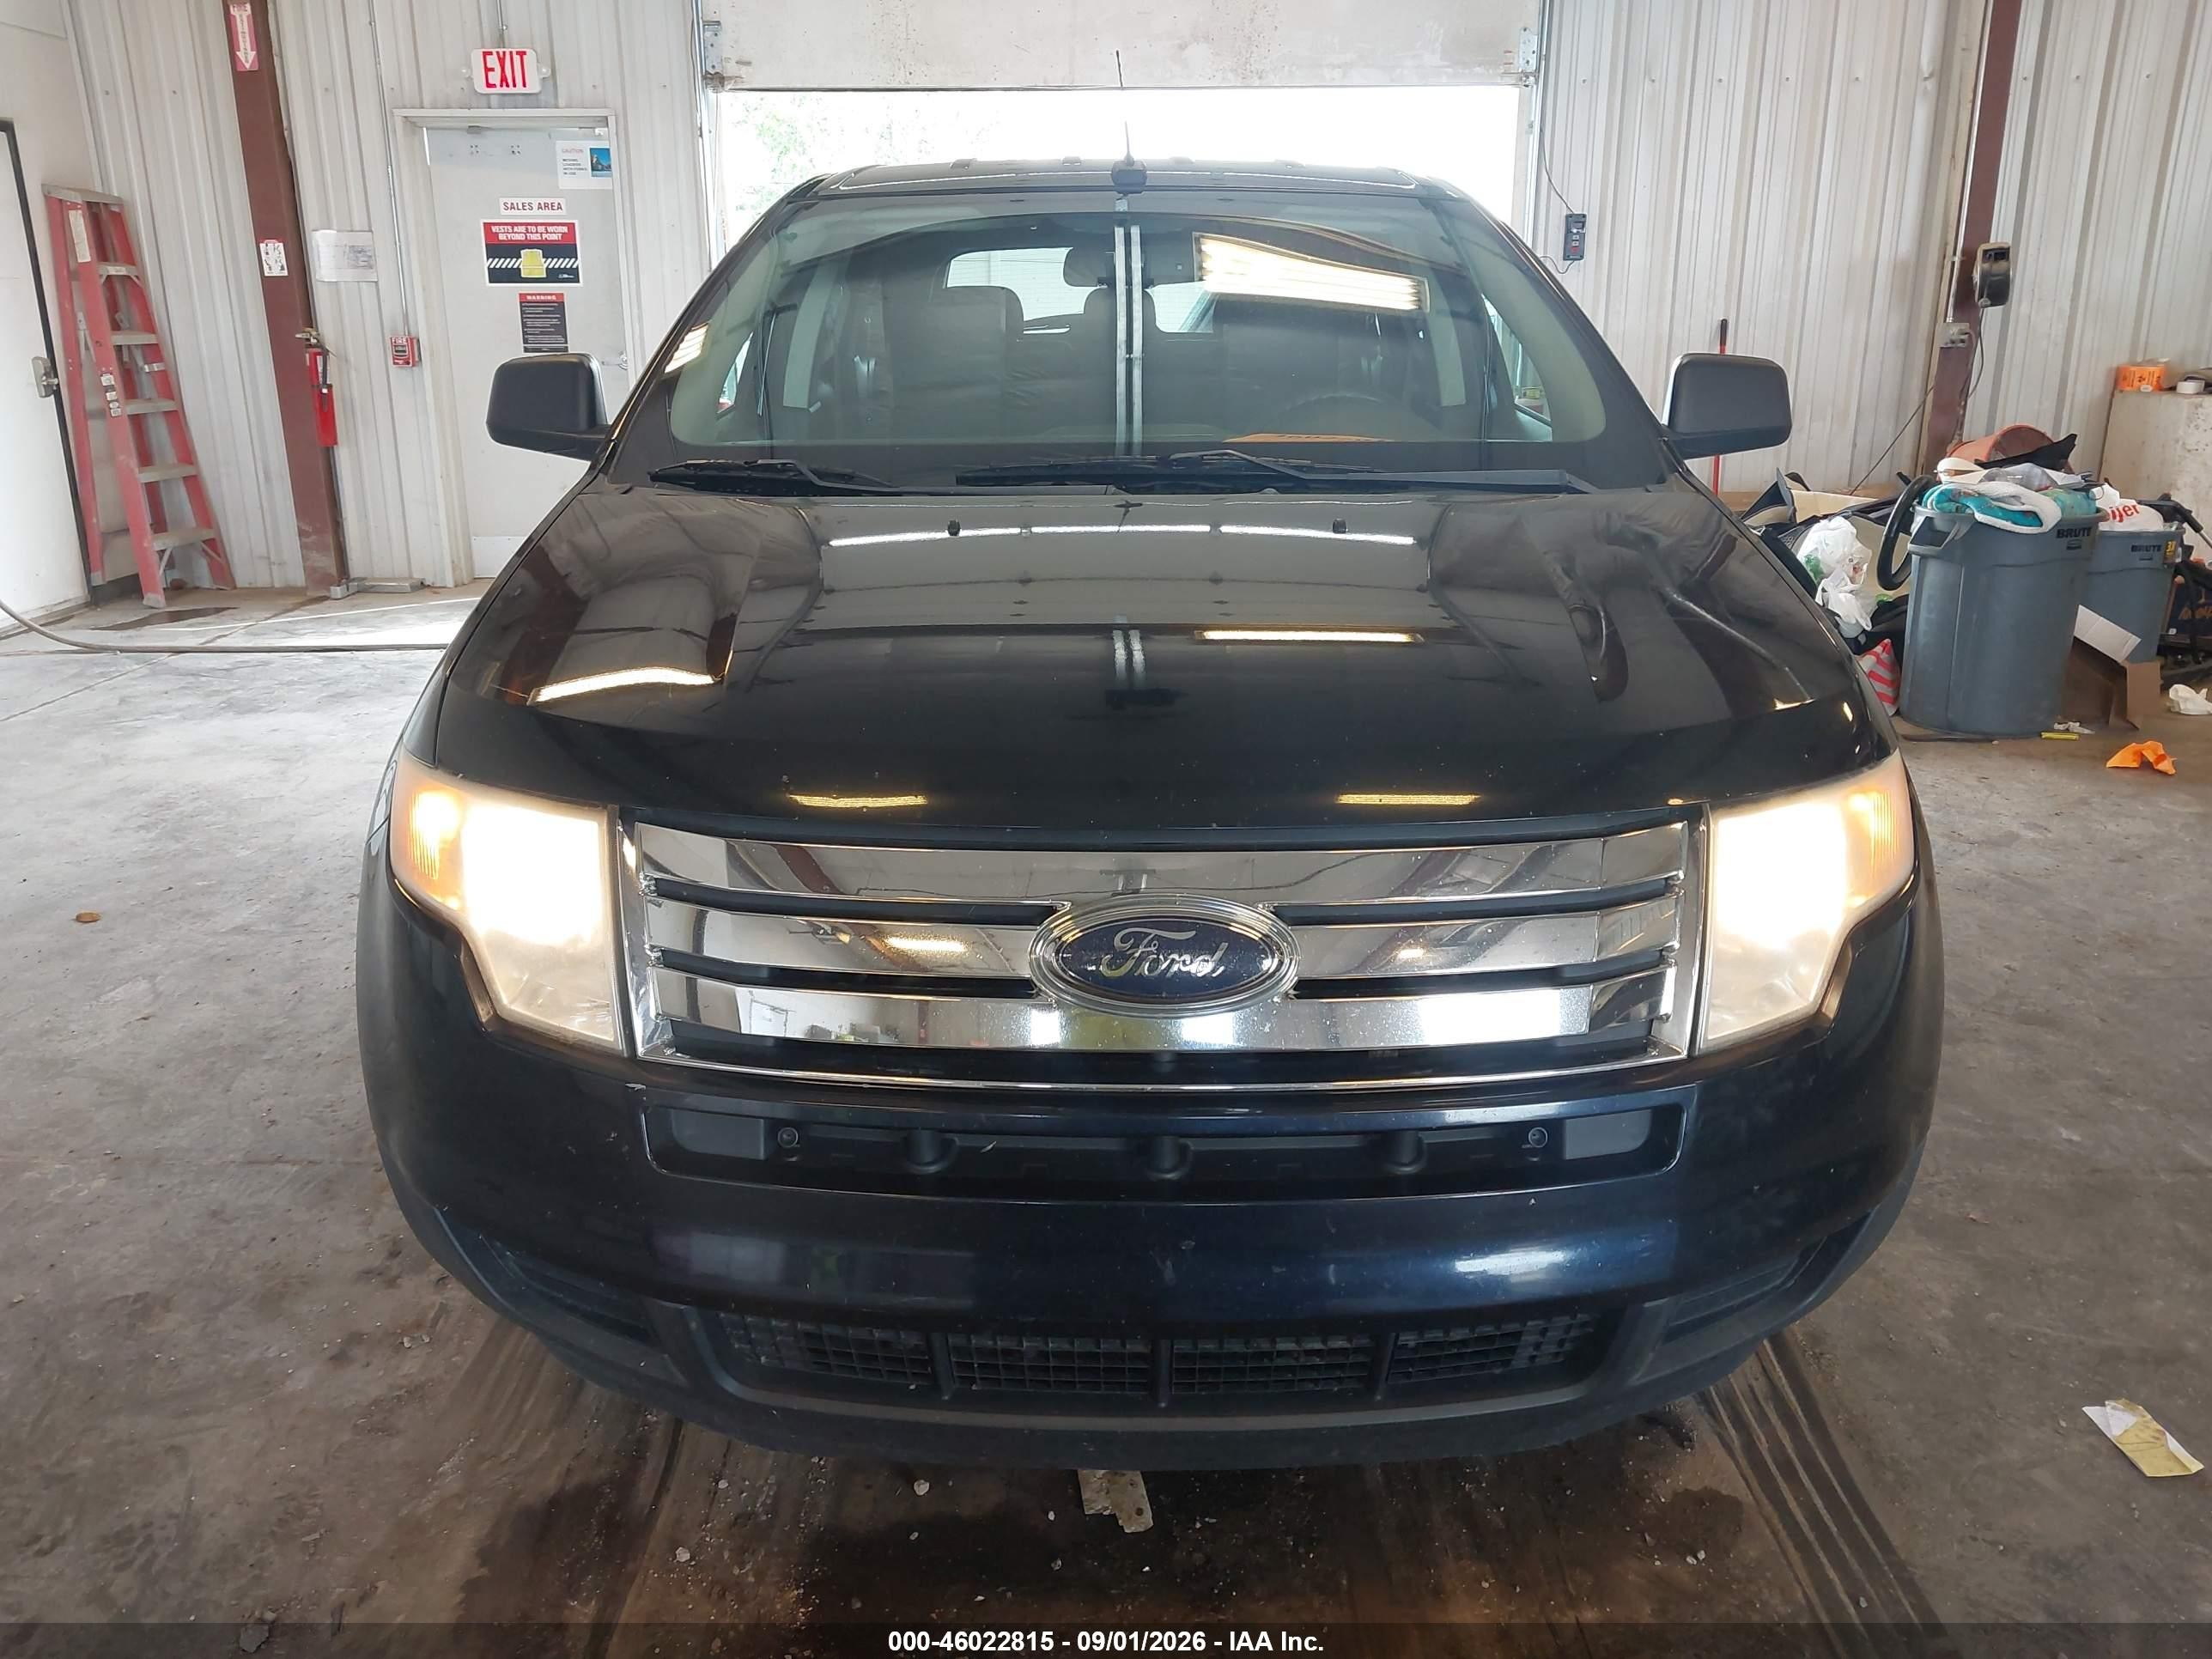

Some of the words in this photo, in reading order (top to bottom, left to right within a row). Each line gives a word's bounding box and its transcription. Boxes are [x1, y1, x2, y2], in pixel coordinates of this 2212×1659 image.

[482, 51, 527, 88] EXIT
[502, 202, 534, 211] SALES
[537, 202, 563, 211] AREA
[2109, 504, 2140, 523] ijer
[1101, 927, 1230, 977] Ford
